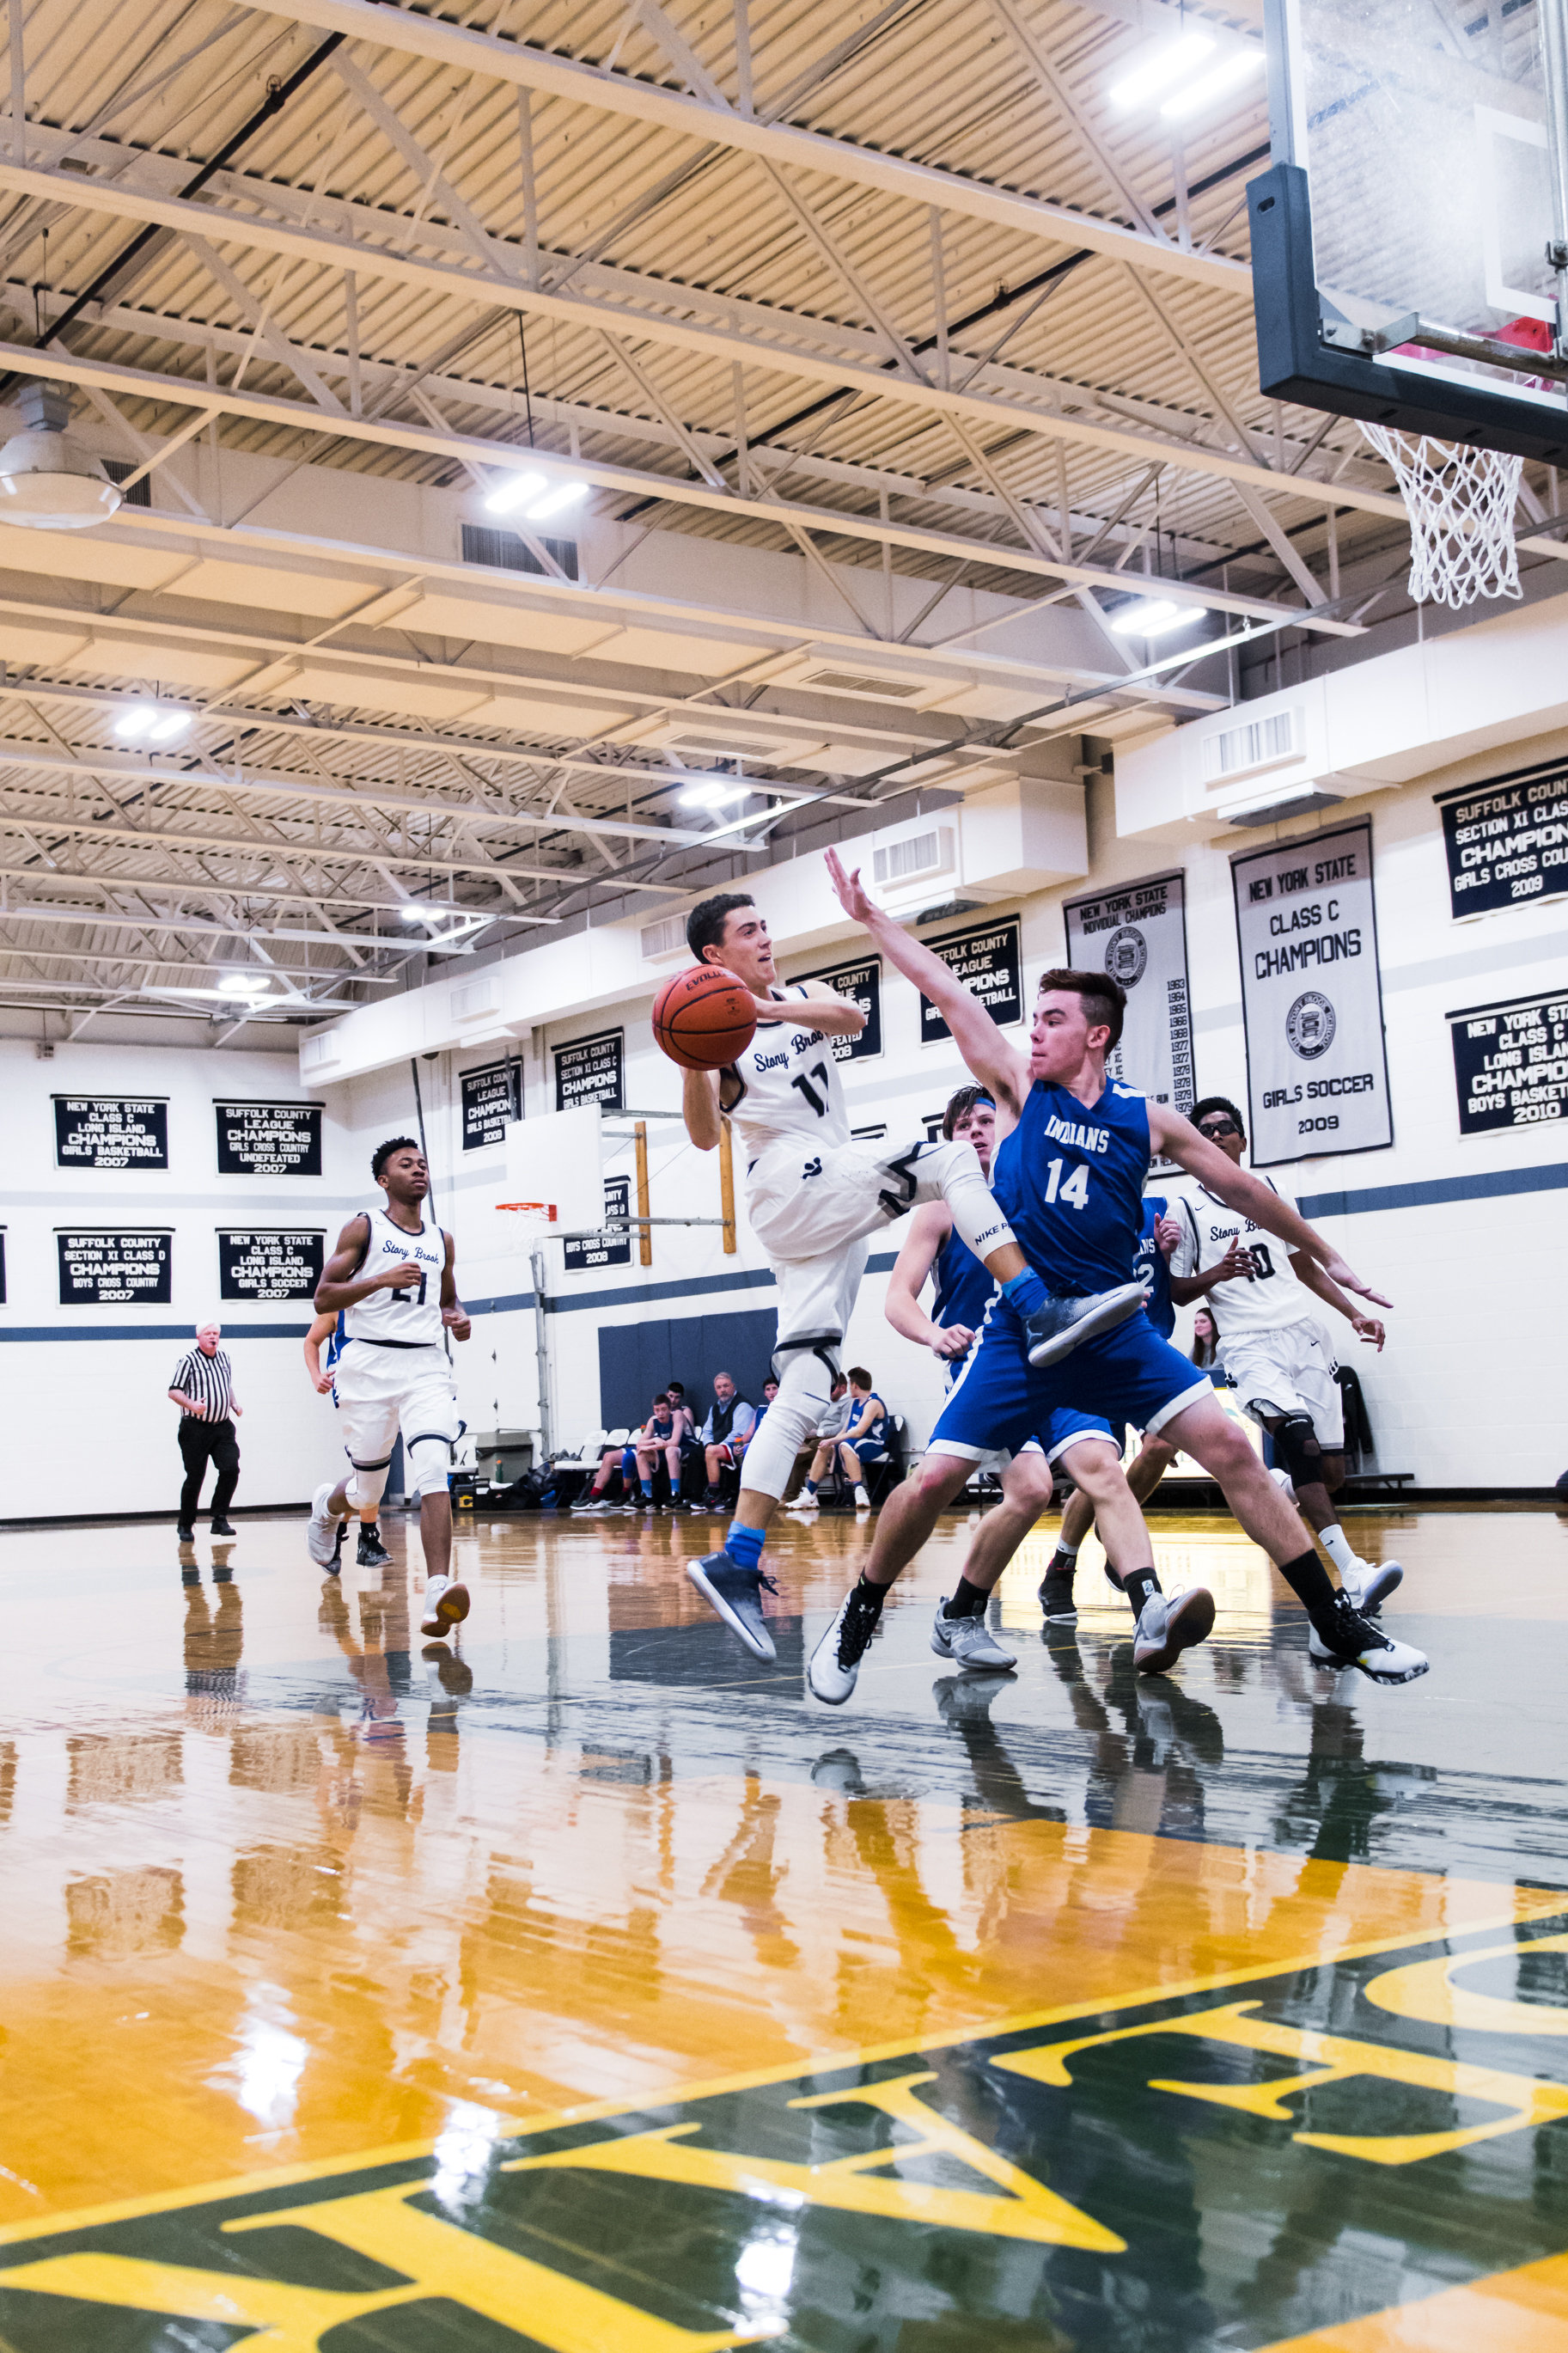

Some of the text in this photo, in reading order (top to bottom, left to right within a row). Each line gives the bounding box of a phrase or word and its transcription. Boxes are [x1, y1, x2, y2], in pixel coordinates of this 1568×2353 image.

[1455, 778, 1568, 823] SUFFOLK COUN
[1455, 816, 1508, 845] SECTION
[1514, 810, 1528, 829] XI
[1461, 822, 1568, 868] CHAMPION
[1249, 853, 1356, 902] NEW YORK STATE
[1454, 867, 1491, 892] GIRLS
[1495, 854, 1537, 880] CROSS
[1510, 875, 1543, 898] 2009
[1080, 885, 1168, 921] NEW YORK STATE
[1126, 901, 1166, 924] CHAMPIONS
[1270, 900, 1339, 936] CLASS C
[971, 933, 1008, 955] COUNTY
[1255, 928, 1362, 980] CHAMPIONS
[952, 955, 993, 976] EAGUE
[837, 969, 870, 988] COUNTY
[1467, 1018, 1496, 1038] NEW
[1504, 1008, 1542, 1031] YORK
[1172, 1040, 1188, 1052] 1977
[1498, 1023, 1565, 1050] CLASS C
[562, 1042, 615, 1066] SUFFOLK COUNTY
[754, 1030, 825, 1072] Stony Broo
[1172, 1052, 1189, 1064] 1977
[561, 1056, 617, 1080] SECTION XI CLASS C
[1484, 1050, 1522, 1072] LONG
[467, 1076, 491, 1091] SUFFOLK
[563, 1071, 617, 1096] CHAMPIONS
[1472, 1060, 1568, 1095] CHAMPIO
[478, 1086, 506, 1102] LEAGUE
[564, 1087, 617, 1109] GIRLS BASKETBALL
[1263, 1073, 1374, 1109] GIRLS SOCCER
[1467, 1081, 1568, 1114] BOYS BASKET
[67, 1102, 155, 1114] NEW YORK STATE
[226, 1109, 311, 1120] SUFFOLK COUNTY
[1514, 1102, 1561, 1123] 2010
[88, 1113, 134, 1123] CLASS C
[244, 1119, 295, 1130] LEAGUE
[1298, 1115, 1339, 1134] 2009
[77, 1122, 145, 1134] LONG ISLAND
[227, 1129, 311, 1143] CHAMPIONS
[1044, 1114, 1109, 1153] INDIANS
[68, 1133, 156, 1146] CHAMPIONS
[229, 1142, 309, 1152] GIRLS CROSS COUNTRY
[62, 1146, 163, 1157] GIRLS BASKETBALL
[240, 1153, 300, 1164] UNDEFEATED
[95, 1157, 129, 1167] 2007
[253, 1164, 287, 1173] 2007
[1045, 1158, 1089, 1210] 14
[68, 1238, 161, 1248] SUFFOLK COUNTY
[230, 1236, 313, 1245] NEW YORK STATE
[974, 1225, 999, 1246] NIKE
[251, 1246, 294, 1256] CLASS C
[382, 1240, 439, 1264] Stony Brook
[566, 1241, 581, 1253] BOYS
[582, 1238, 601, 1250] CROSS
[64, 1250, 165, 1261] SECTION XI CLASS D
[241, 1256, 303, 1265] LONG ISLAND
[586, 1251, 608, 1264] 2008
[70, 1263, 160, 1275] CHAMPIONS
[231, 1266, 314, 1278] CHAMPIONS
[73, 1277, 158, 1288] BOYS CROSS COUNTRY
[239, 1279, 308, 1288] GIRLS SOCCER
[99, 1290, 134, 1300] 2007
[258, 1289, 290, 1299] 2007
